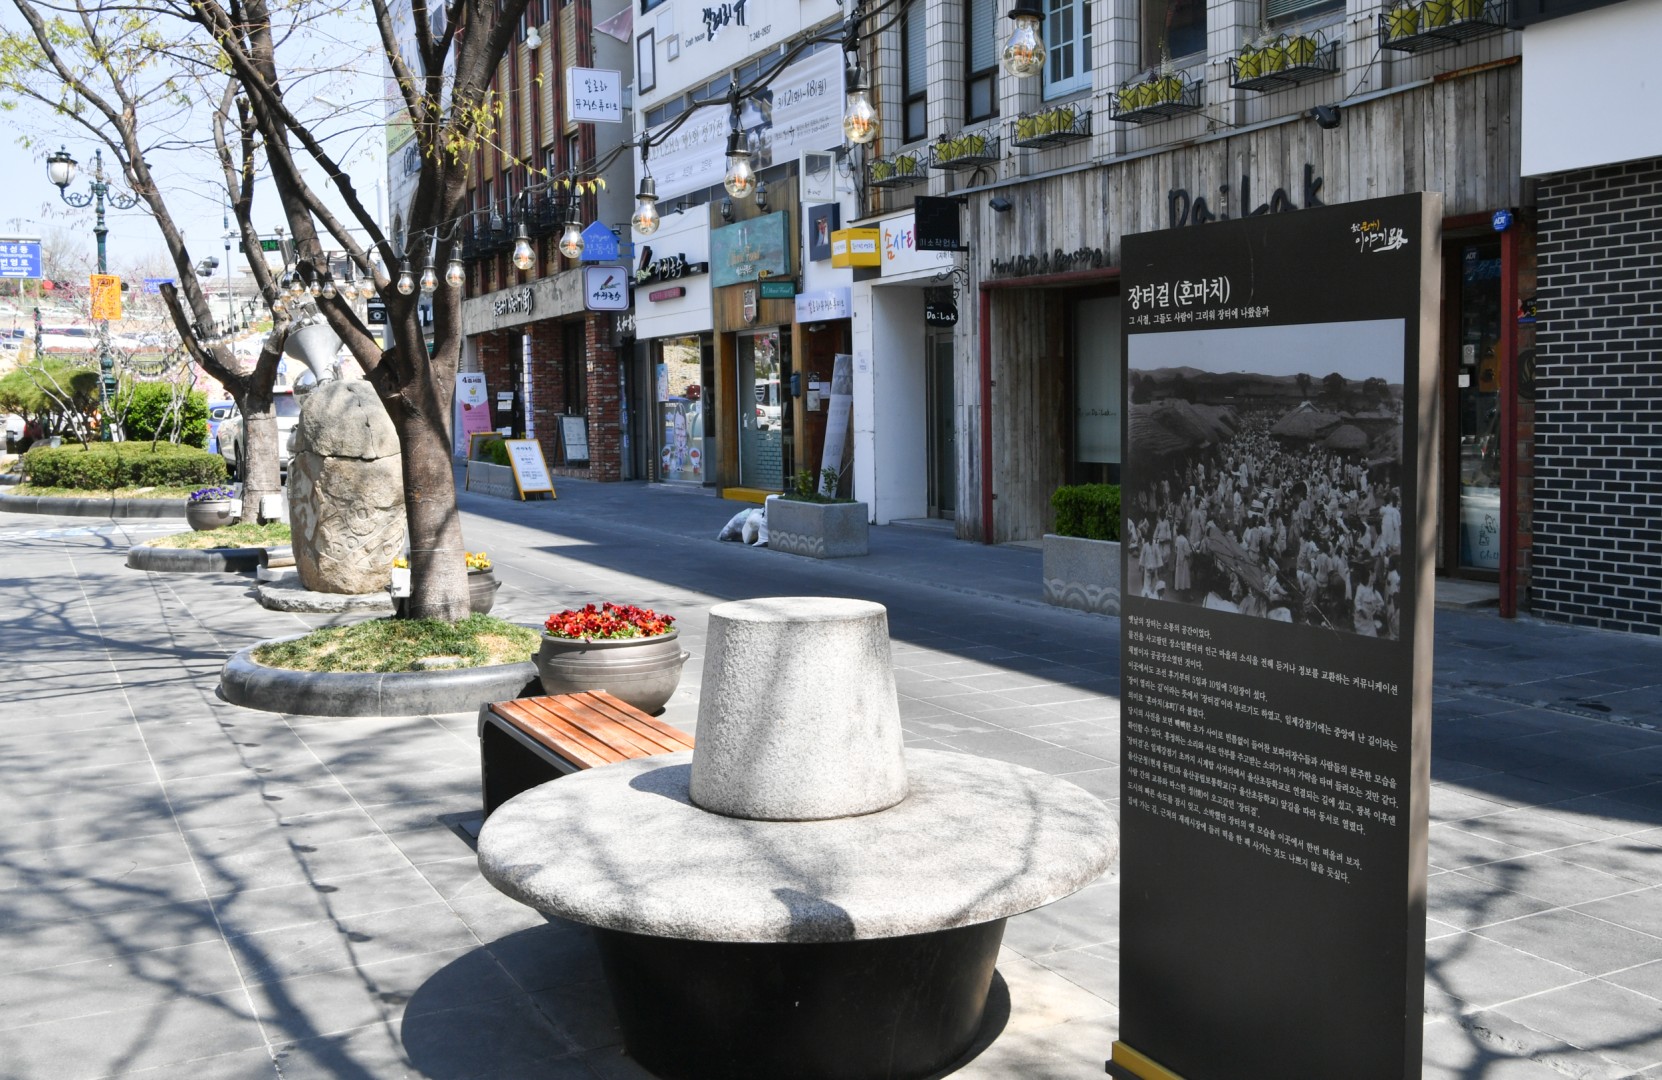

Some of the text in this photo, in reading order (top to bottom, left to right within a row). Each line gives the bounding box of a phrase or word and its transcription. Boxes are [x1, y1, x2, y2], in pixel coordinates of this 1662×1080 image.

[1494, 216, 1506, 226] ADT
[991, 256, 1015, 274] Hand
[1128, 276, 1230, 310] 장터걸 (혼마치)
[926, 311, 956, 321] Da:Lak
[1128, 306, 1270, 326] 그 시절, 그들도 사람이 그리워 장터에 나왔을까
[1144, 617, 1162, 630] 장터는
[1162, 621, 1180, 633] 소통의
[1127, 629, 1144, 642] 물건을
[1145, 633, 1167, 647] 사고팔던
[1218, 648, 1237, 662] 마을의
[1239, 653, 1259, 666] 소식을
[1260, 657, 1274, 669] 전해
[1275, 660, 1296, 674] 듣거나
[1298, 665, 1319, 679] 정보를
[1320, 670, 1350, 685] 교환하는
[1352, 676, 1398, 696] 커뮤니케이션
[1127, 660, 1154, 674] 이곳에서도
[1155, 667, 1166, 678] 조선
[1167, 669, 1190, 683] 후기부터
[1191, 675, 1207, 688] 5일과
[1208, 679, 1227, 692] 10일에
[1228, 684, 1251, 698] 5일장이
[1128, 691, 1143, 702] 의미로
[1139, 678, 1156, 691] 열리는
[1181, 688, 1198, 702] 뜻에서
[1234, 702, 1259, 716] 부르기도
[1284, 714, 1332, 735] 일제강점기에는
[1333, 726, 1355, 741] 중앙에
[1357, 732, 1365, 744] 난
[1367, 735, 1398, 752] 길이라는
[1127, 706, 1143, 718] 당시의
[1144, 710, 1160, 723] 사진을
[1161, 715, 1173, 726] 보면
[1192, 723, 1204, 735] 초가
[1205, 727, 1224, 739] 사이로
[1225, 732, 1249, 747] 빈틈없이
[1251, 739, 1270, 754] 들어찬
[1271, 746, 1318, 767] 보따리장수들과
[1319, 758, 1347, 775] 사람들의
[1349, 767, 1372, 782] 분주한
[1373, 774, 1397, 789] 모습을
[1143, 725, 1150, 734] 수
[1186, 738, 1204, 751] 소리와
[1205, 743, 1217, 754] 서로
[1217, 747, 1236, 760] 안부를
[1237, 752, 1261, 768] 주고받는
[1262, 760, 1282, 774] 소리가
[1283, 766, 1296, 778] 마치
[1297, 770, 1318, 784] 가락을
[1319, 776, 1333, 789] 타며
[1334, 780, 1363, 798] 들려오는
[1365, 789, 1380, 803] 것만
[1127, 766, 1138, 777] 사람
[1139, 770, 1150, 781] 간의
[1151, 774, 1168, 787] 교류와
[1169, 780, 1186, 793] 따스한
[1210, 793, 1234, 810] 오고갔던
[1150, 743, 1177, 759] 일제강점기
[1197, 757, 1214, 770] 시계탑
[1215, 762, 1245, 780] 사거리에서
[1246, 772, 1291, 793] 울산초등학교로
[1292, 786, 1319, 803] 연결되는
[1321, 794, 1335, 808] 길에
[1356, 805, 1371, 818] 광복
[1373, 810, 1396, 826] 이후엔
[1182, 768, 1237, 793] 울산공립보통학교(구
[1238, 786, 1278, 807] 울산초등학교)
[1280, 799, 1301, 814] 앞길을
[1302, 806, 1316, 819] 따라
[1318, 811, 1340, 826] 동서로
[1127, 781, 1143, 794] 도시의
[1156, 791, 1173, 804] 속도를
[1174, 797, 1186, 808] 잠시
[1202, 807, 1226, 823] 소박했던
[1228, 815, 1246, 830] 장터의
[1248, 822, 1255, 833] 옛
[1256, 825, 1276, 840] 모습을
[1277, 832, 1304, 850] 이곳에서
[1306, 842, 1320, 856] 한번
[1322, 848, 1343, 863] 떠올려
[1139, 800, 1150, 811] 가는
[1160, 807, 1176, 821] 근처의
[1208, 824, 1220, 837] 들러
[1235, 834, 1242, 844] 한
[1252, 840, 1271, 855] 사가는
[1273, 848, 1286, 860] 것도
[1288, 853, 1308, 868] 나쁘지
[1310, 861, 1324, 874] 않을
